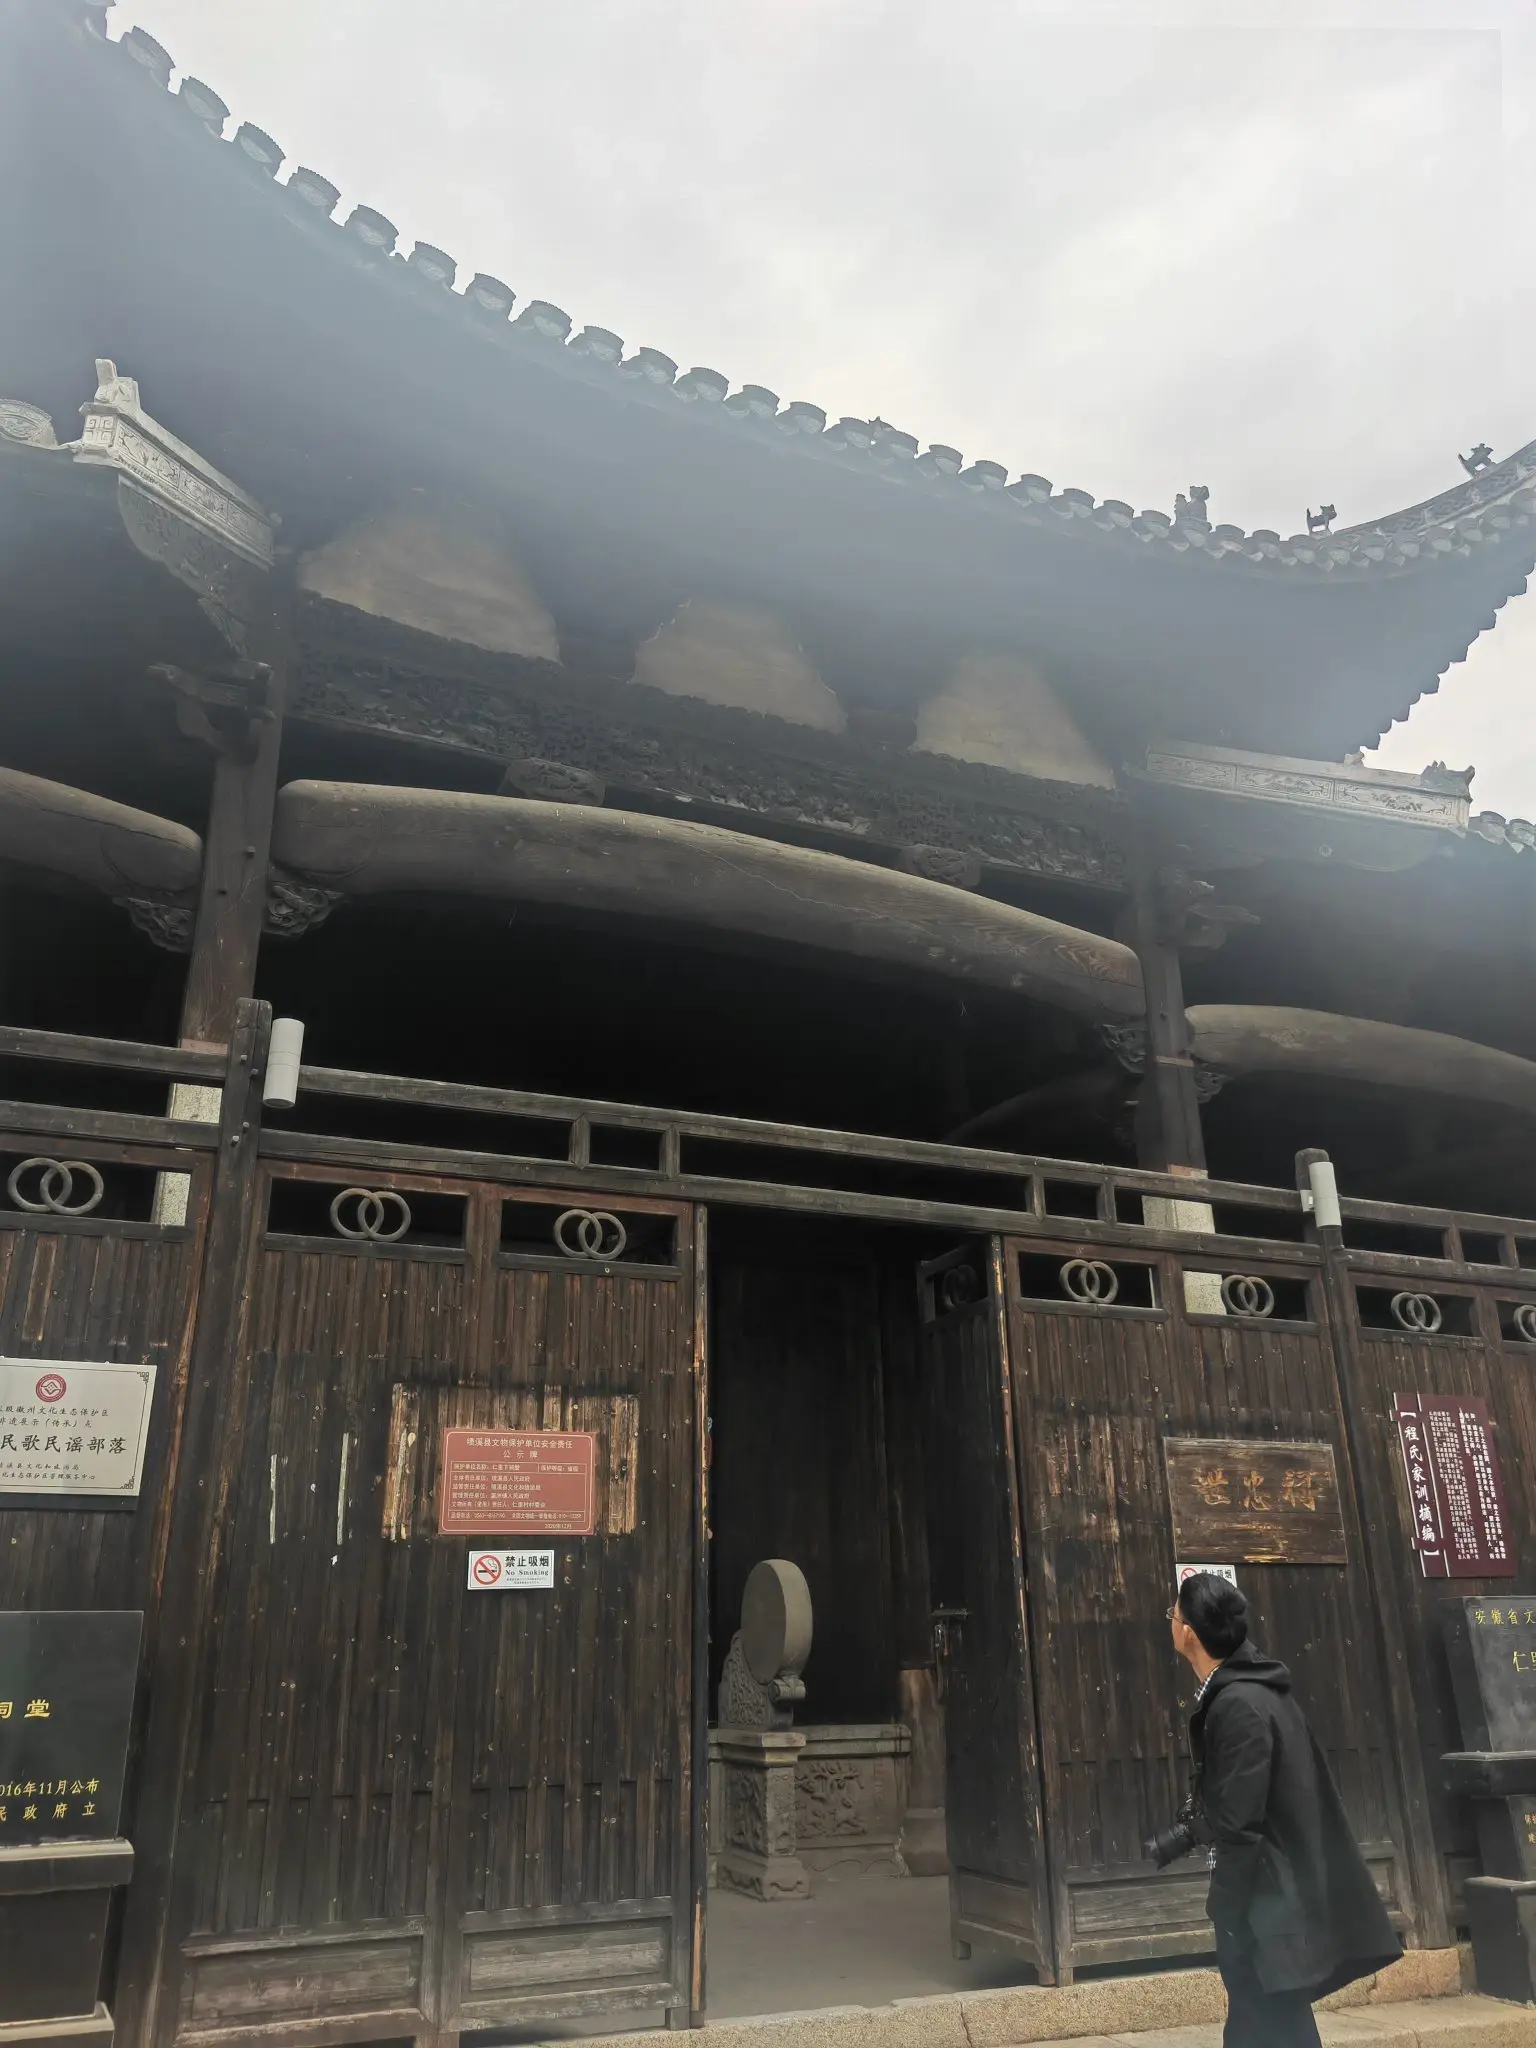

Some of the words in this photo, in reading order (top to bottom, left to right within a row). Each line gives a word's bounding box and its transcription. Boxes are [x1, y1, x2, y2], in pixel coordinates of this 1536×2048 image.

[1, 1434, 127, 1455] 民歌民谣部落
[466, 1437, 573, 1450] 绩溪县文物保护单位安全责任
[505, 1555, 549, 1568] 禁止吸烟
